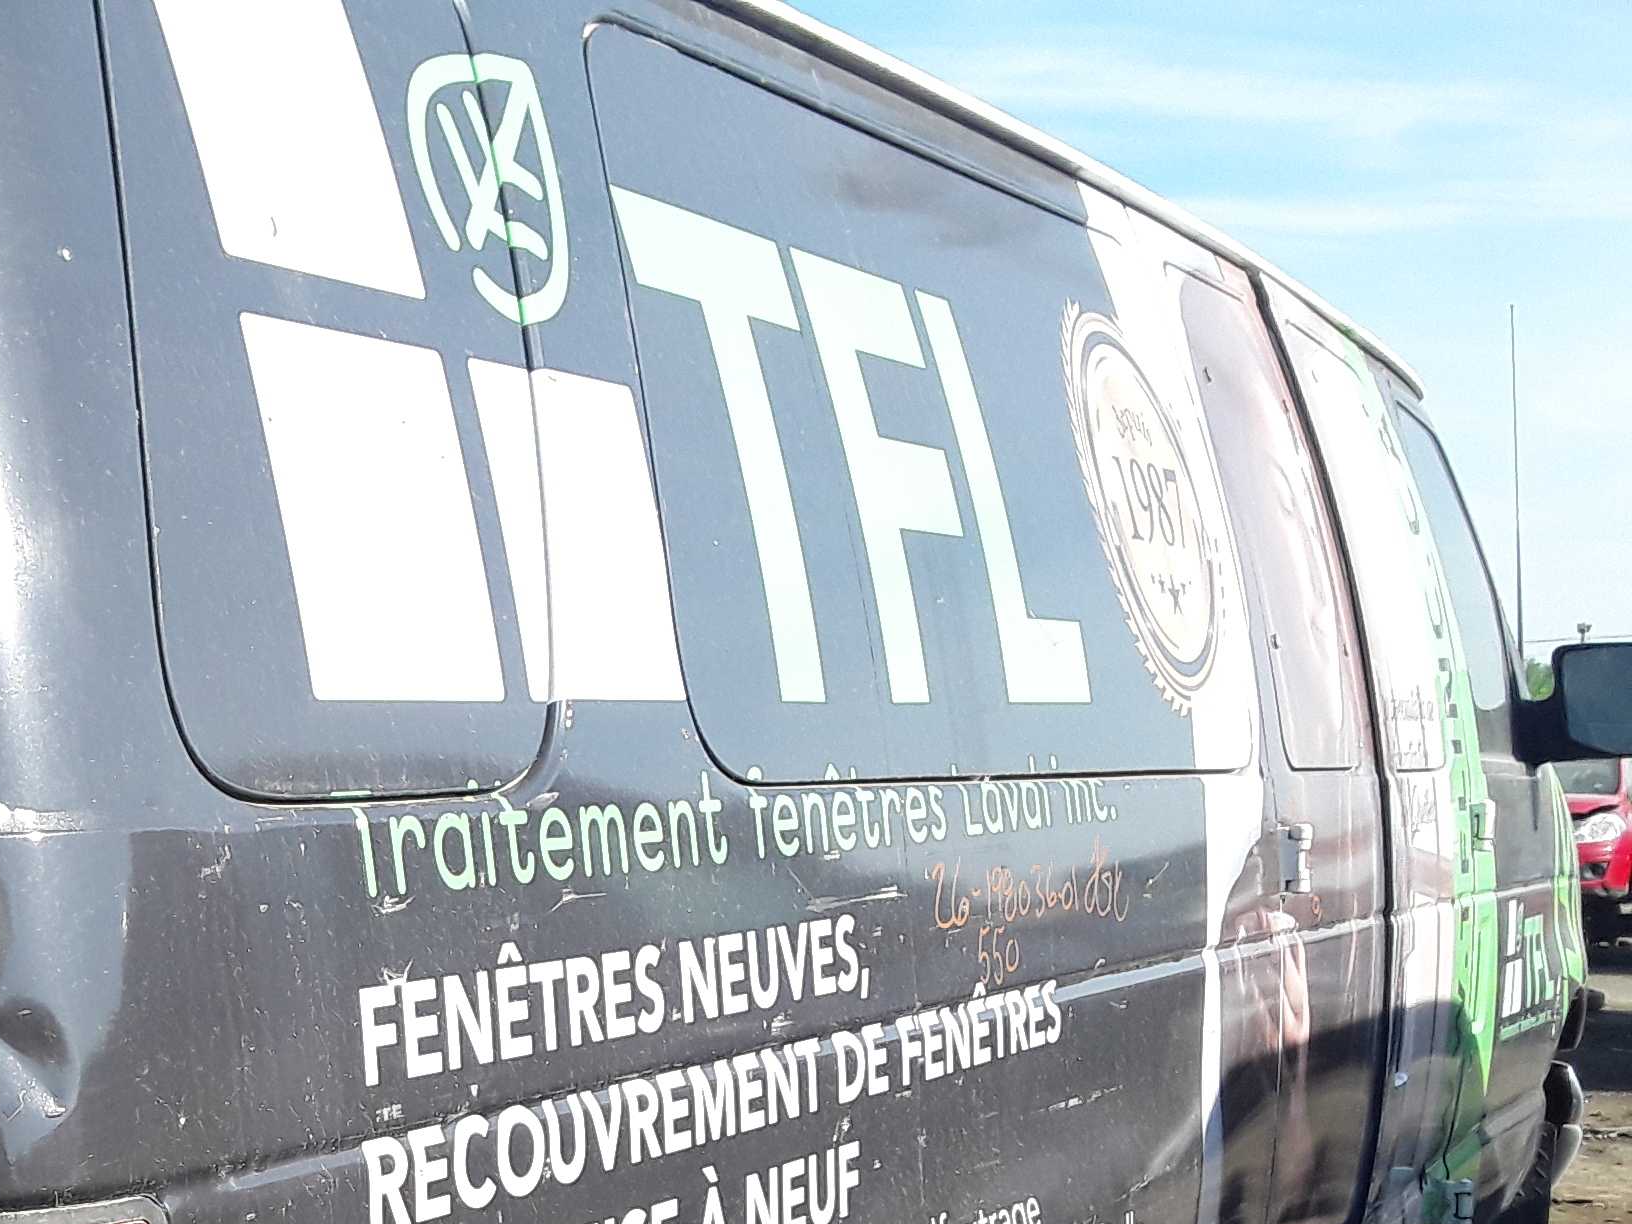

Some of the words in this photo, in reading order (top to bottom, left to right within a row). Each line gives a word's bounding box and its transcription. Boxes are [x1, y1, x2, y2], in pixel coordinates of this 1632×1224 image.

[609, 184, 1091, 703] TFL
[1111, 456, 1186, 549] 1987
[330, 771, 729, 899] Traitement
[746, 763, 948, 860] fenêtres
[951, 753, 1053, 837] Laval
[1048, 754, 1118, 826] inc.
[359, 941, 666, 1088] FENÊTRES
[680, 913, 871, 1025] NEUVES,
[978, 925, 1020, 985] 550
[831, 1022, 890, 1105] DE
[895, 978, 1063, 1088] FENÊTRES
